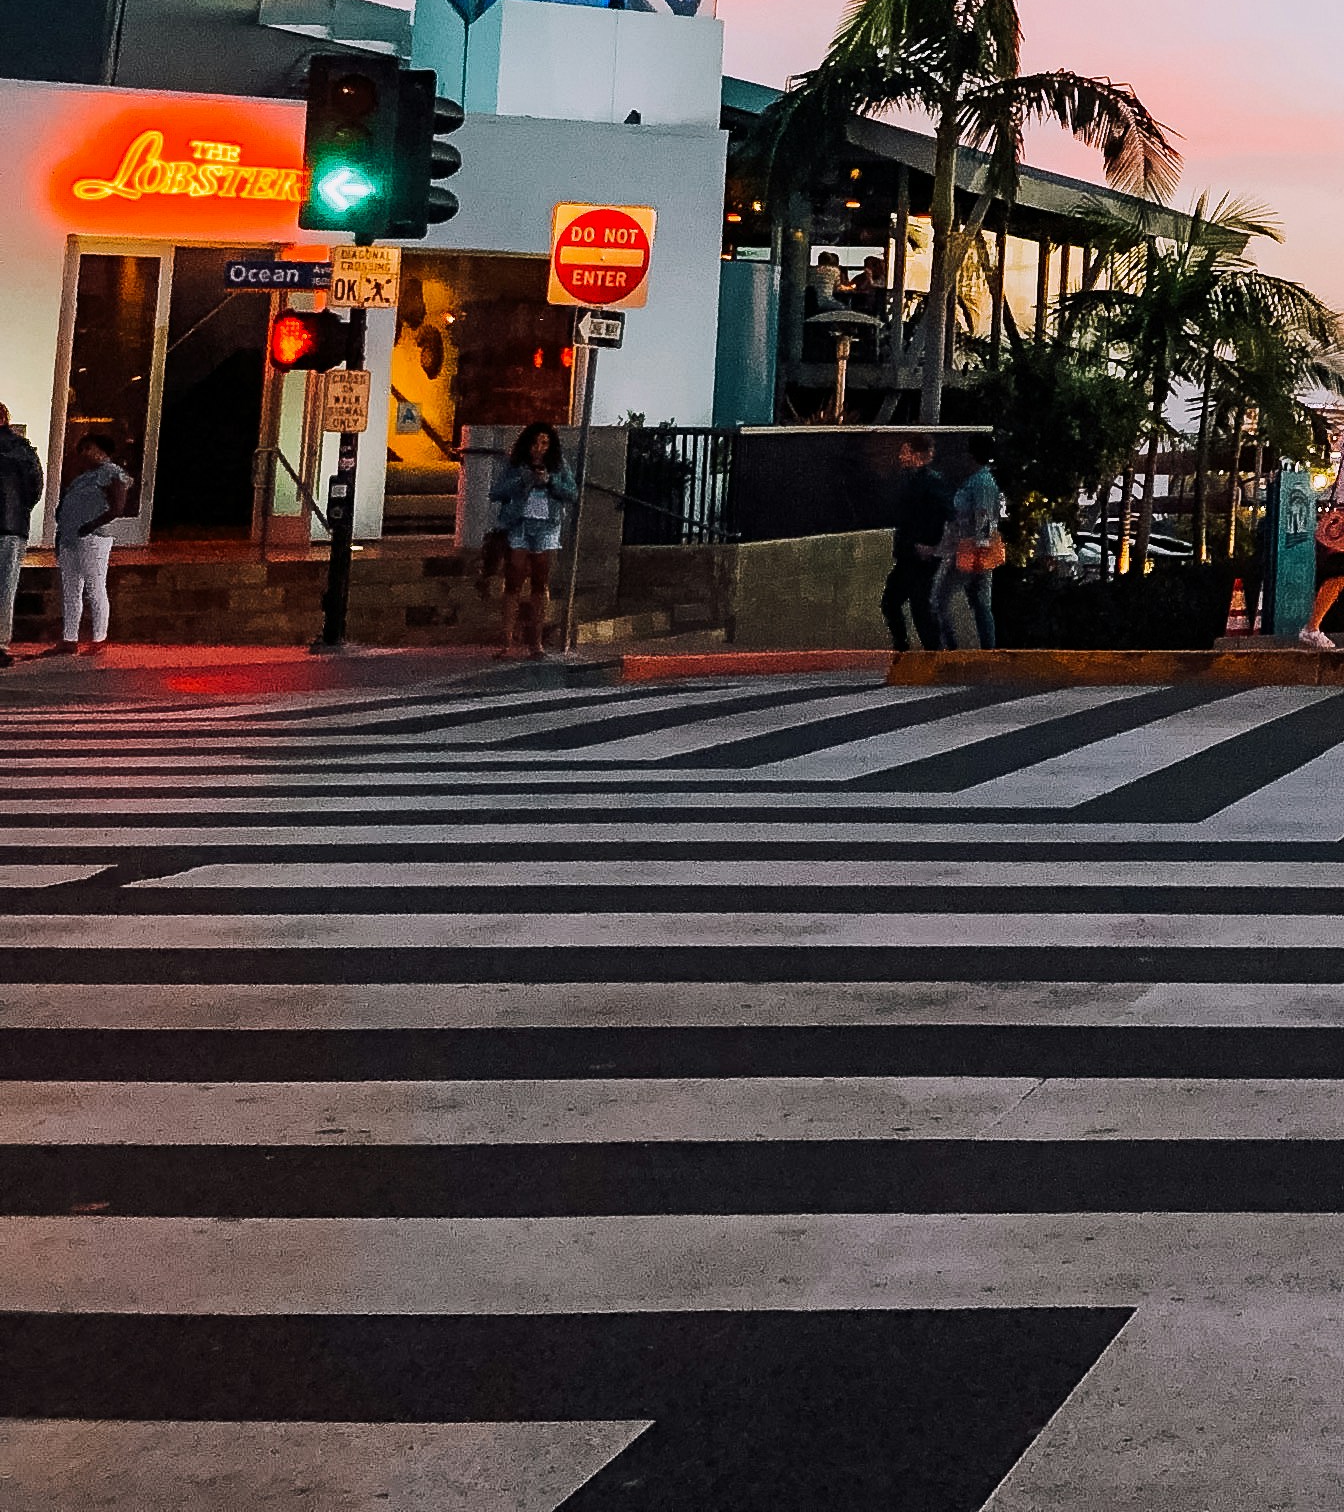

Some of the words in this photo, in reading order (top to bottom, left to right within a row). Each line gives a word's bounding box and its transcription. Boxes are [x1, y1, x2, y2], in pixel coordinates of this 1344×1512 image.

[189, 140, 241, 163] THE
[571, 226, 596, 243] DO
[604, 228, 639, 244] NOT
[229, 264, 300, 283] Ocean
[571, 269, 628, 287] ENTER
[334, 278, 357, 301] OK
[332, 417, 360, 428] ONLY
